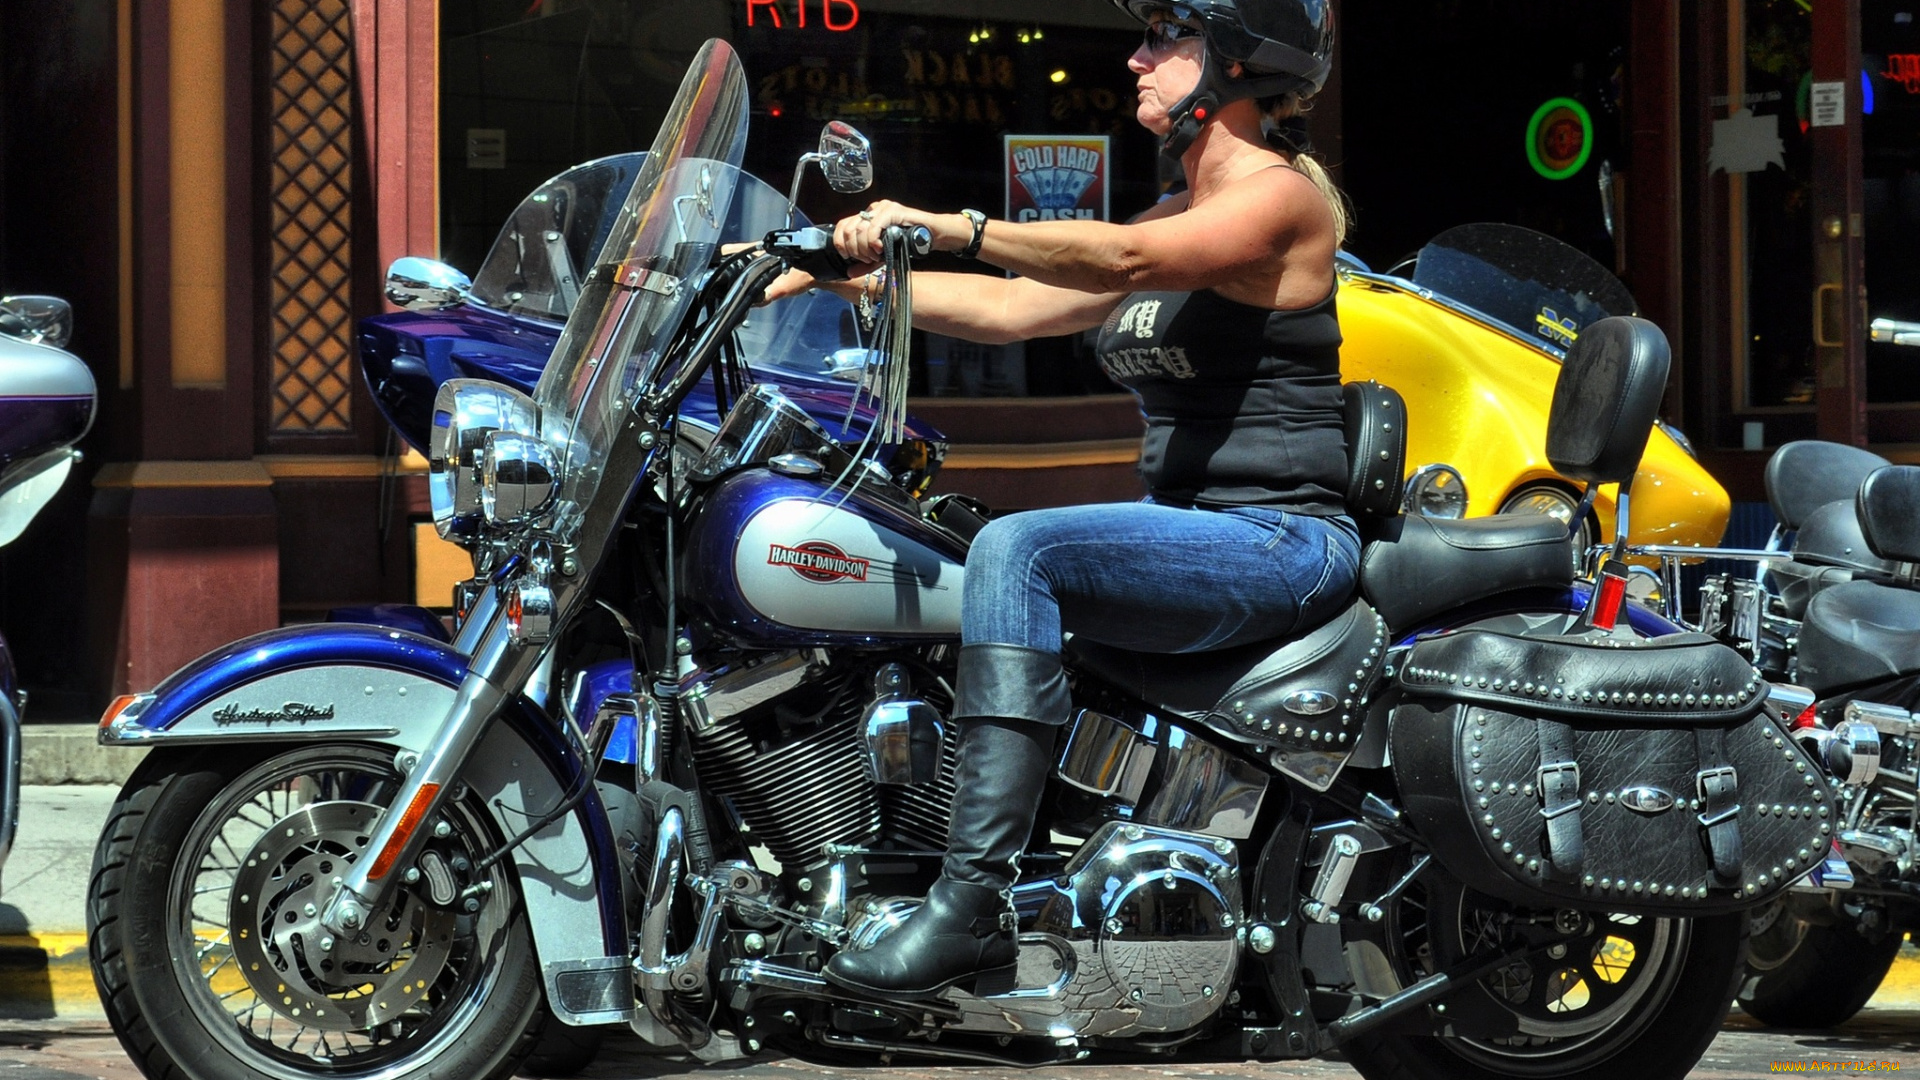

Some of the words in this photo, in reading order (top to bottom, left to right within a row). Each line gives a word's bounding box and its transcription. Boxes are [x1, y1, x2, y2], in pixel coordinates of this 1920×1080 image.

[1013, 146, 1054, 173] COLD
[1057, 146, 1099, 173] HARD
[1019, 208, 1094, 223] CASH
